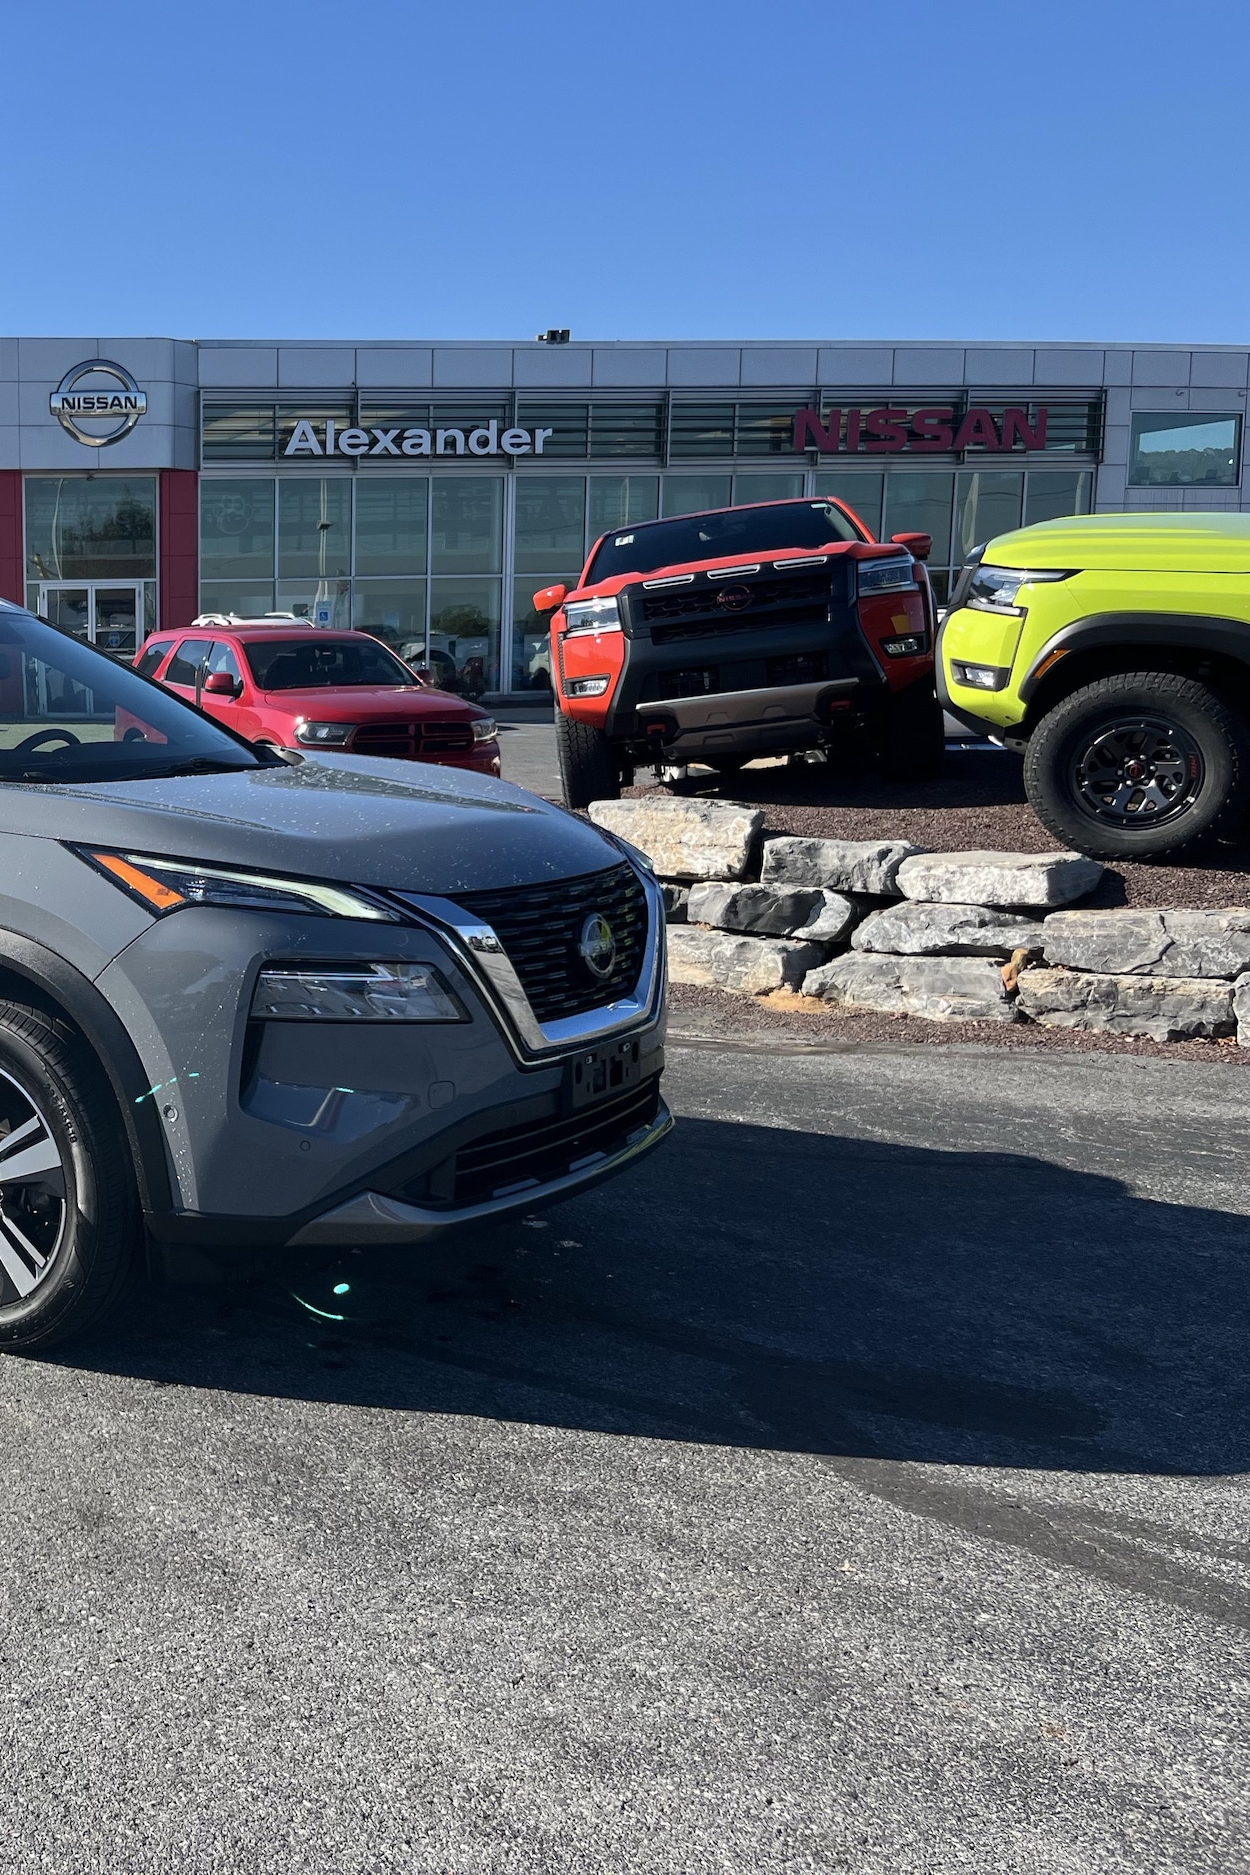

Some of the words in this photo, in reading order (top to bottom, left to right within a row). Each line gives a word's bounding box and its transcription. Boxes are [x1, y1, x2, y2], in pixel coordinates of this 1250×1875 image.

[61, 396, 137, 410] NISSAN
[284, 420, 552, 456] Alexander
[794, 408, 1048, 450] NISSAN
